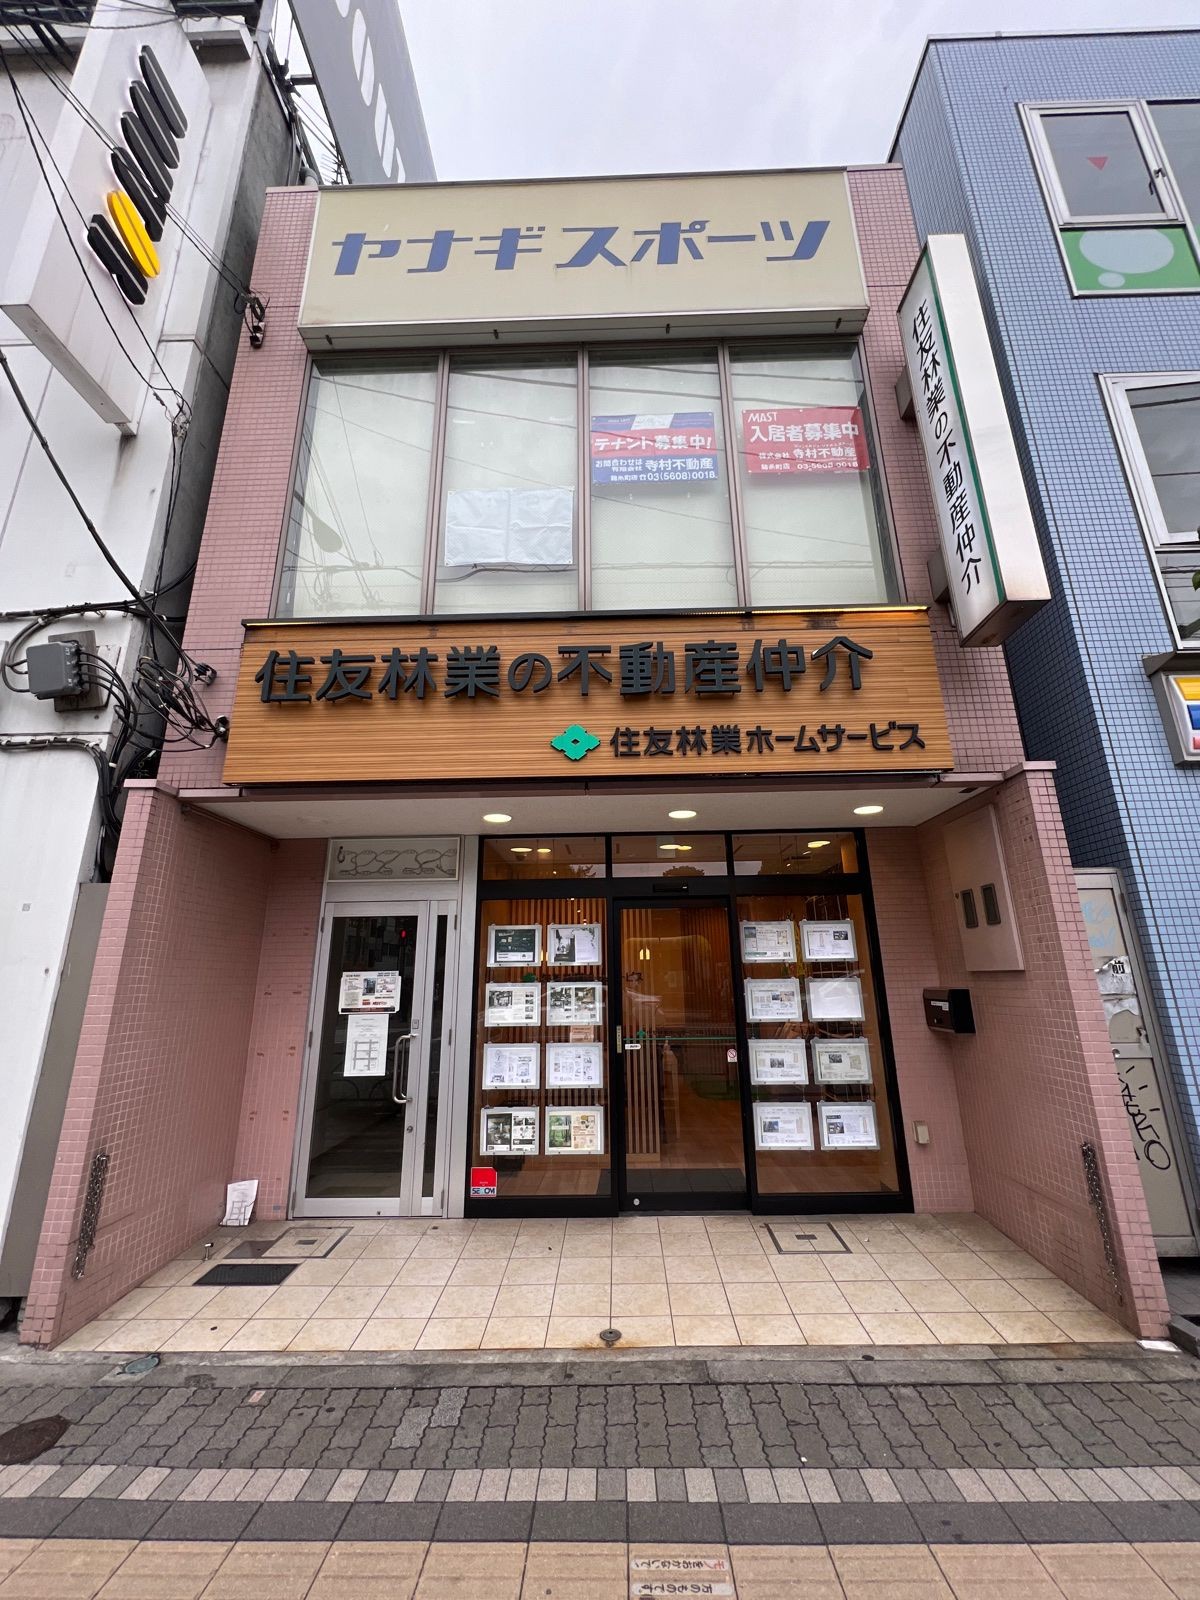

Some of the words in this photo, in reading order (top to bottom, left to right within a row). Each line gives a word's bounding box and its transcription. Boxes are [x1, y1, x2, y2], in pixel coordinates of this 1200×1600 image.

[333, 220, 830, 276] ヤナギスポーツ
[748, 412, 777, 423] MAST
[594, 434, 712, 451] テナント募集中!
[750, 421, 859, 443] 入居者募集中
[793, 446, 857, 459] 寺村不動産
[912, 299, 982, 595] 住友林業の不動産仲介
[645, 457, 714, 472] 寺村不動産
[254, 636, 874, 704] 住友林業の不動産仲介
[609, 722, 926, 758] 住友林業ホームサービス
